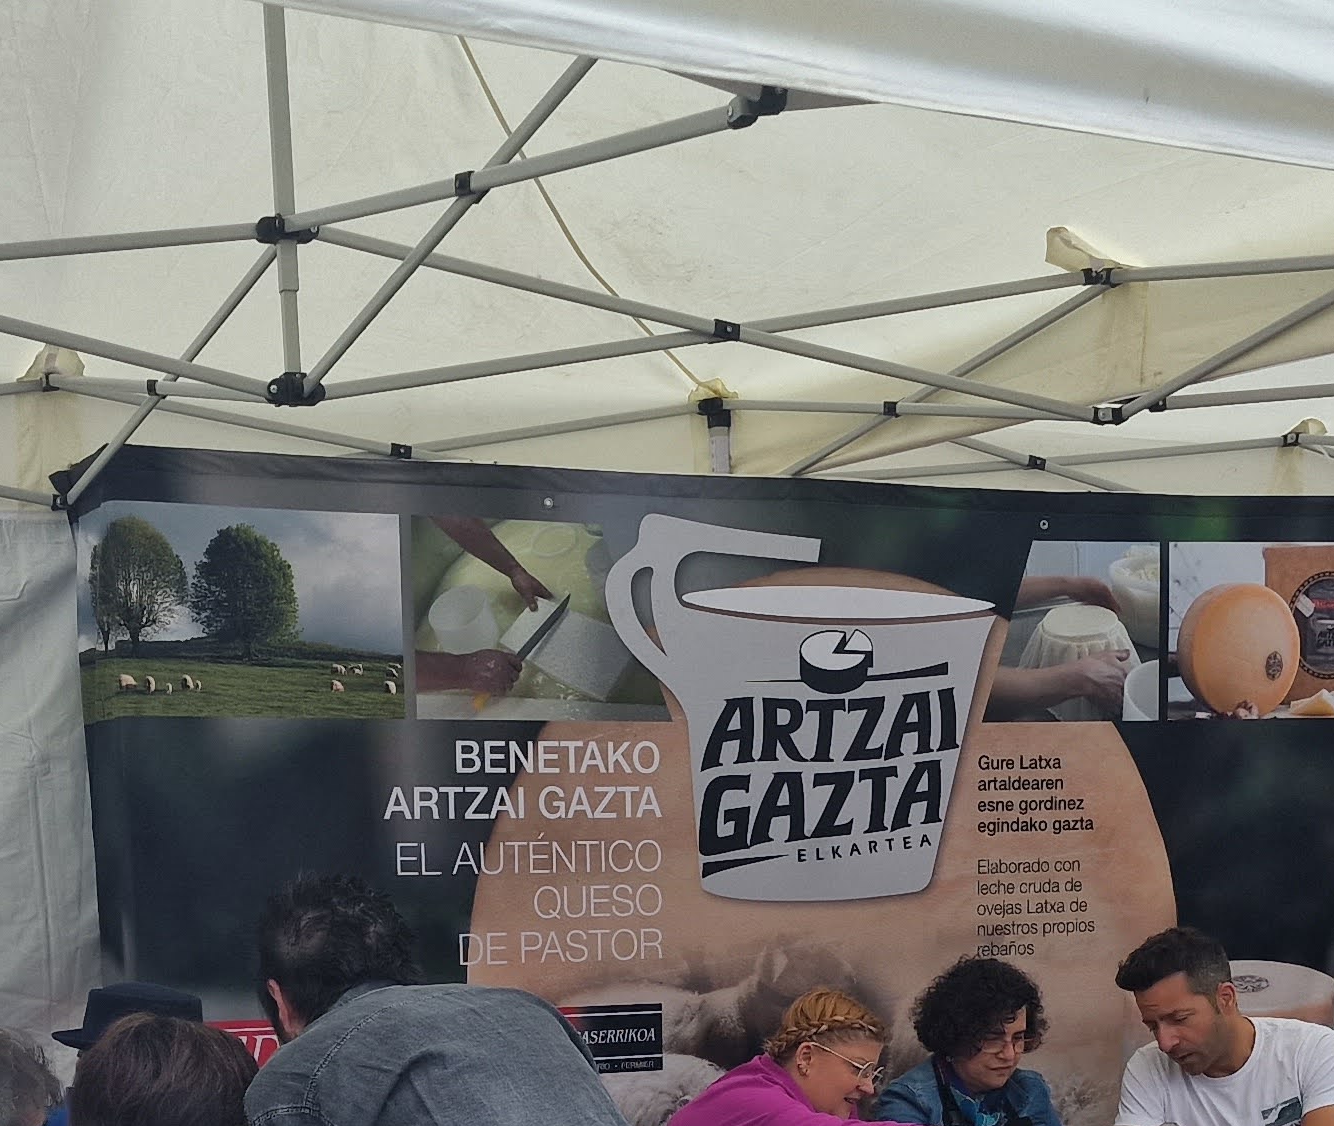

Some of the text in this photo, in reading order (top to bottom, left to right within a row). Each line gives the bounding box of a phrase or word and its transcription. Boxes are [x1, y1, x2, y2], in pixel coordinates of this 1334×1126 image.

[701, 687, 959, 772] ARTZAI
[455, 740, 660, 774] BENETAKO
[978, 754, 1061, 771] Gure Latxa
[977, 776, 1064, 792] artaldearen
[383, 786, 663, 820] ARTZAI GAZTA
[699, 759, 942, 856] GAZTA
[977, 796, 1084, 815] esne gordinez
[977, 817, 1094, 836] egindako gazta
[396, 832, 662, 876] EL AUTÉNTICO
[798, 834, 931, 862] ELKARTEA
[977, 858, 1081, 875] Elaborado con
[977, 878, 1083, 896] leche cruda de
[533, 884, 662, 920] QUESO
[977, 898, 1088, 918] ovejas Latxa de
[977, 919, 1095, 938] nuestros propios
[458, 928, 663, 966] DE PASTOR
[977, 941, 1035, 957] rebaños
[578, 1027, 656, 1045] ASERRIKOA
